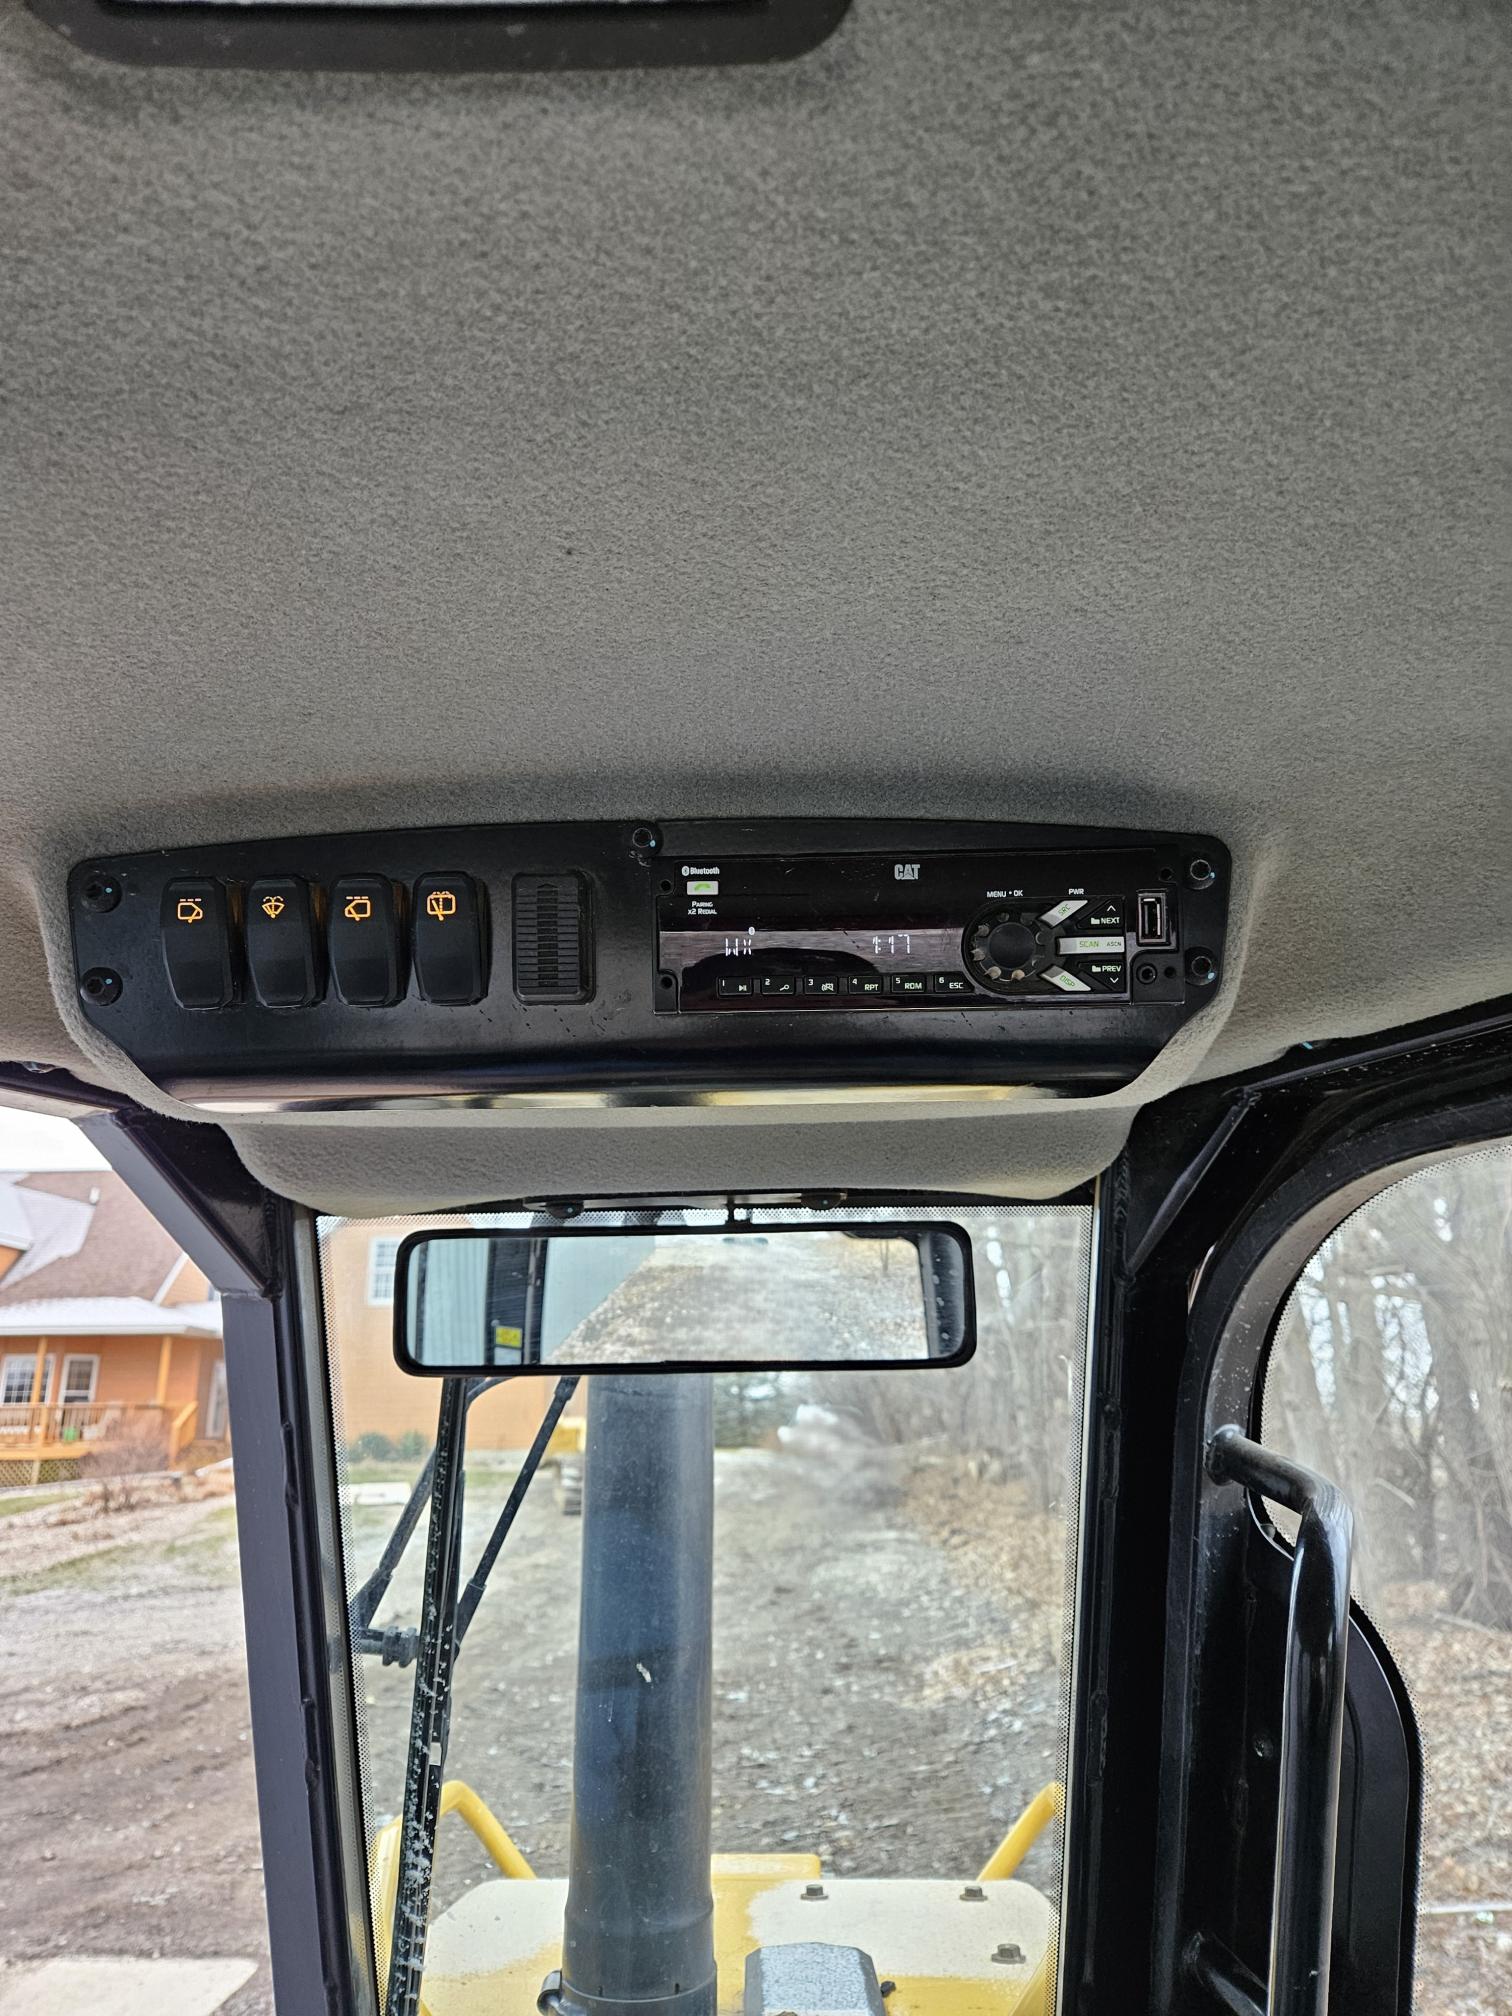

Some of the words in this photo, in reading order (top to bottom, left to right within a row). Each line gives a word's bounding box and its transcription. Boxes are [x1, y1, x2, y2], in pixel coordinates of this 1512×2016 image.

[690, 866, 720, 875] Bluetooth
[894, 864, 920, 880] CAT
[987, 890, 1006, 898] MENU
[1058, 904, 1072, 916] SRC
[872, 934, 910, 954] 1:17
[1079, 940, 1100, 948] SCAN
[1060, 975, 1076, 986] DISP
[864, 983, 879, 991] RPT
